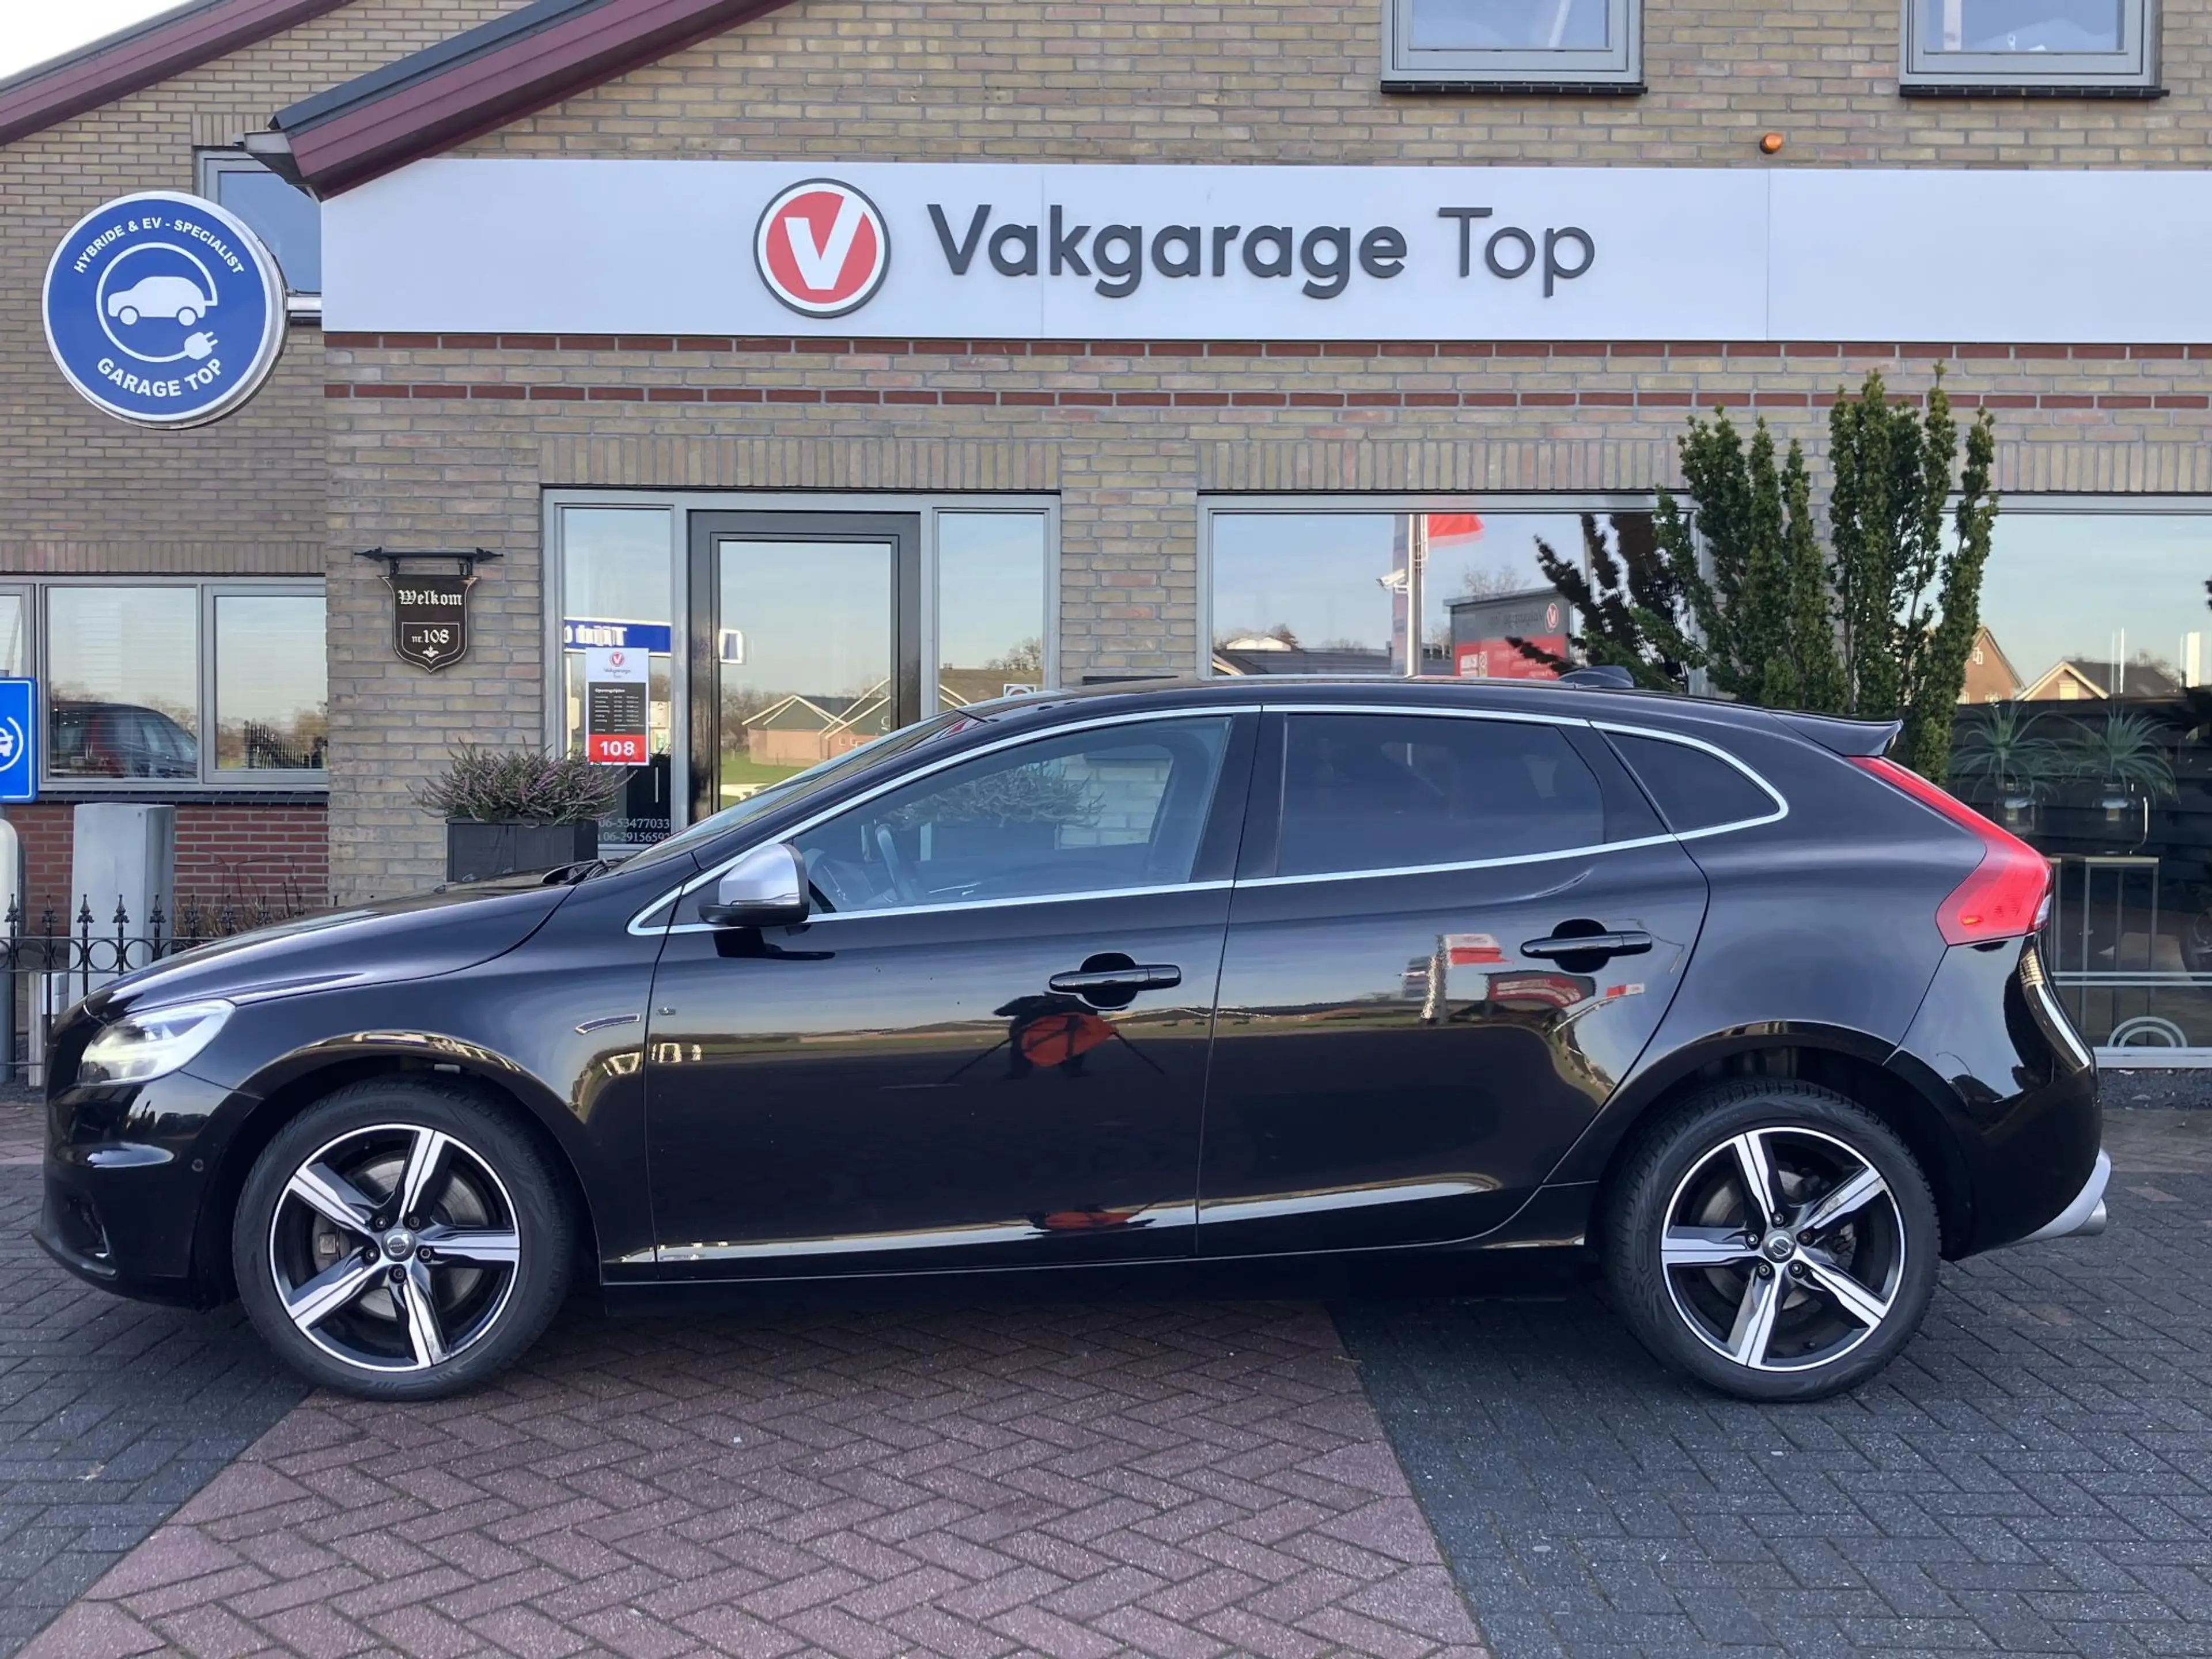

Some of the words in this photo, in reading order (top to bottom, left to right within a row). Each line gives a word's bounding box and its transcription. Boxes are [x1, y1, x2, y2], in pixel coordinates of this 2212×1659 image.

[73, 225, 125, 274] HYBRIDE
[128, 221, 139, 232] &
[142, 217, 162, 229] EV
[174, 220, 244, 274] SPECIALIST
[783, 191, 865, 290] V
[926, 203, 1408, 300] Vakgarage
[1438, 207, 1595, 298] Top
[97, 357, 182, 397] GARAGE
[184, 358, 221, 391] TOP
[397, 589, 463, 605] Welkom
[600, 740, 635, 757] 108
[598, 818, 670, 829] 06-53477033
